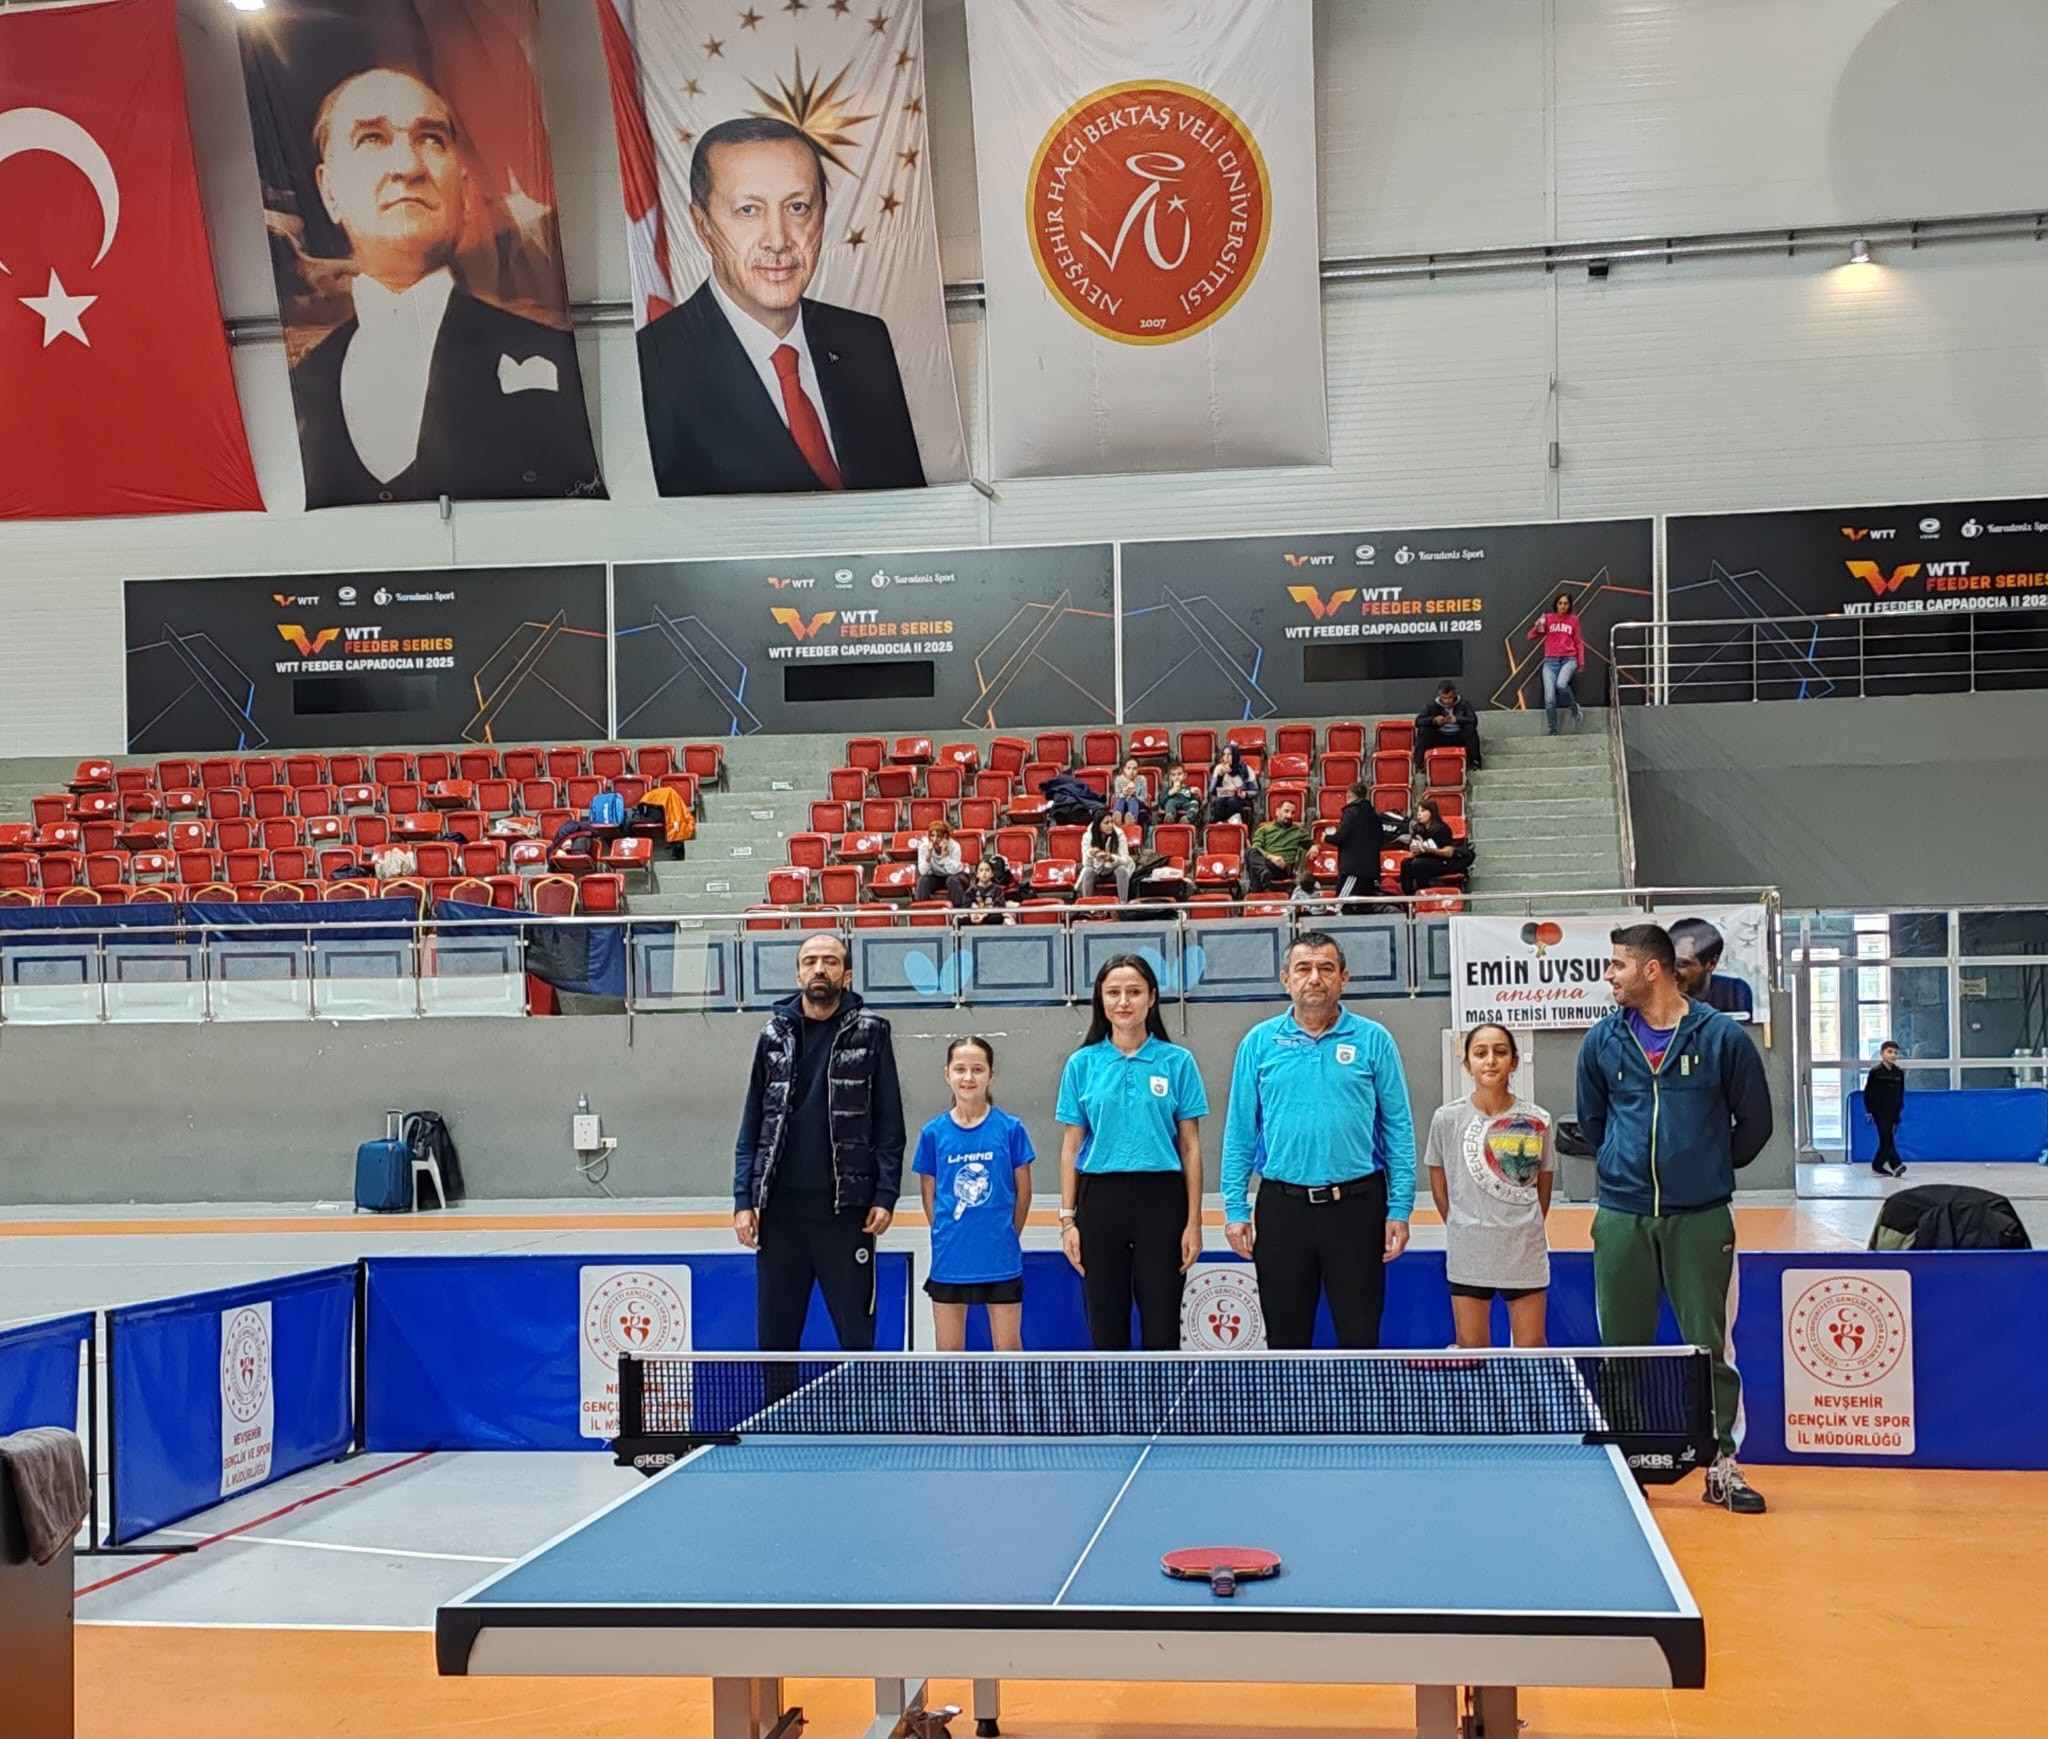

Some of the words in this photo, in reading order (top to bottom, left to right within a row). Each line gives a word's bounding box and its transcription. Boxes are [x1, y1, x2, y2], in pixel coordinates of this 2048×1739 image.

[1083, 105, 1170, 144] BEKTAŞ
[1178, 111, 1226, 154] VELİ
[1048, 137, 1087, 202] HACI
[1179, 150, 1251, 315] ÜNİVERSİTESİ
[1045, 206, 1123, 315] NEVŞEHİR
[1140, 318, 1167, 329] 2007
[1870, 529, 1896, 540] WTT
[1310, 555, 1335, 566] WTT
[1926, 561, 1970, 577] WTT
[792, 579, 815, 589] WTT
[1926, 576, 1991, 591] FEEDER
[1995, 573, 2048, 588] SERIES
[297, 596, 320, 606] WTT
[1362, 587, 1402, 602] WTT
[1362, 601, 1422, 616] FEEDER
[1425, 598, 1482, 614] SERIES
[1843, 603, 1872, 616] WTT
[1874, 600, 1923, 614] FEEDER
[1926, 596, 2008, 611] CAPPADOCIA
[2022, 594, 2048, 607] 202
[840, 610, 879, 624] WTT
[345, 626, 381, 640] WTT
[840, 623, 897, 638] FEEDER
[900, 620, 953, 635] SERIES
[1285, 627, 1312, 639] WTT
[1313, 624, 1359, 637] FEEDER
[1362, 622, 1437, 636] CAPPADOCIA
[1450, 620, 1482, 632] 2025
[345, 640, 399, 654] FEEDER
[402, 638, 453, 652] SERIES
[769, 647, 793, 659] WTT
[795, 645, 839, 657] FEEDER
[840, 642, 912, 656] CAPPADOCIA
[924, 641, 953, 653] 2025
[275, 662, 299, 673] WTT
[302, 660, 343, 672] FEEDER
[345, 658, 414, 671] CAPPADOCIA
[425, 657, 455, 669] 2025
[1466, 955, 1529, 986] EMİN
[1466, 1008, 1502, 1023] MASA
[1507, 1005, 1547, 1022] TENİSİ
[947, 1151, 994, 1164] LI-NING
[583, 1401, 620, 1415] GENÇL
[1814, 1394, 1883, 1410] NEVŞEHİR
[1788, 1413, 1847, 1429] GENÇLİK
[1852, 1415, 1870, 1427] VE
[1874, 1415, 1910, 1428] SPOR
[1797, 1431, 1810, 1445] İL
[1814, 1432, 1902, 1447] MÜDÜRLÜĞÜ
[645, 1454, 676, 1464] KBS
[1640, 1454, 1673, 1465] KBS
